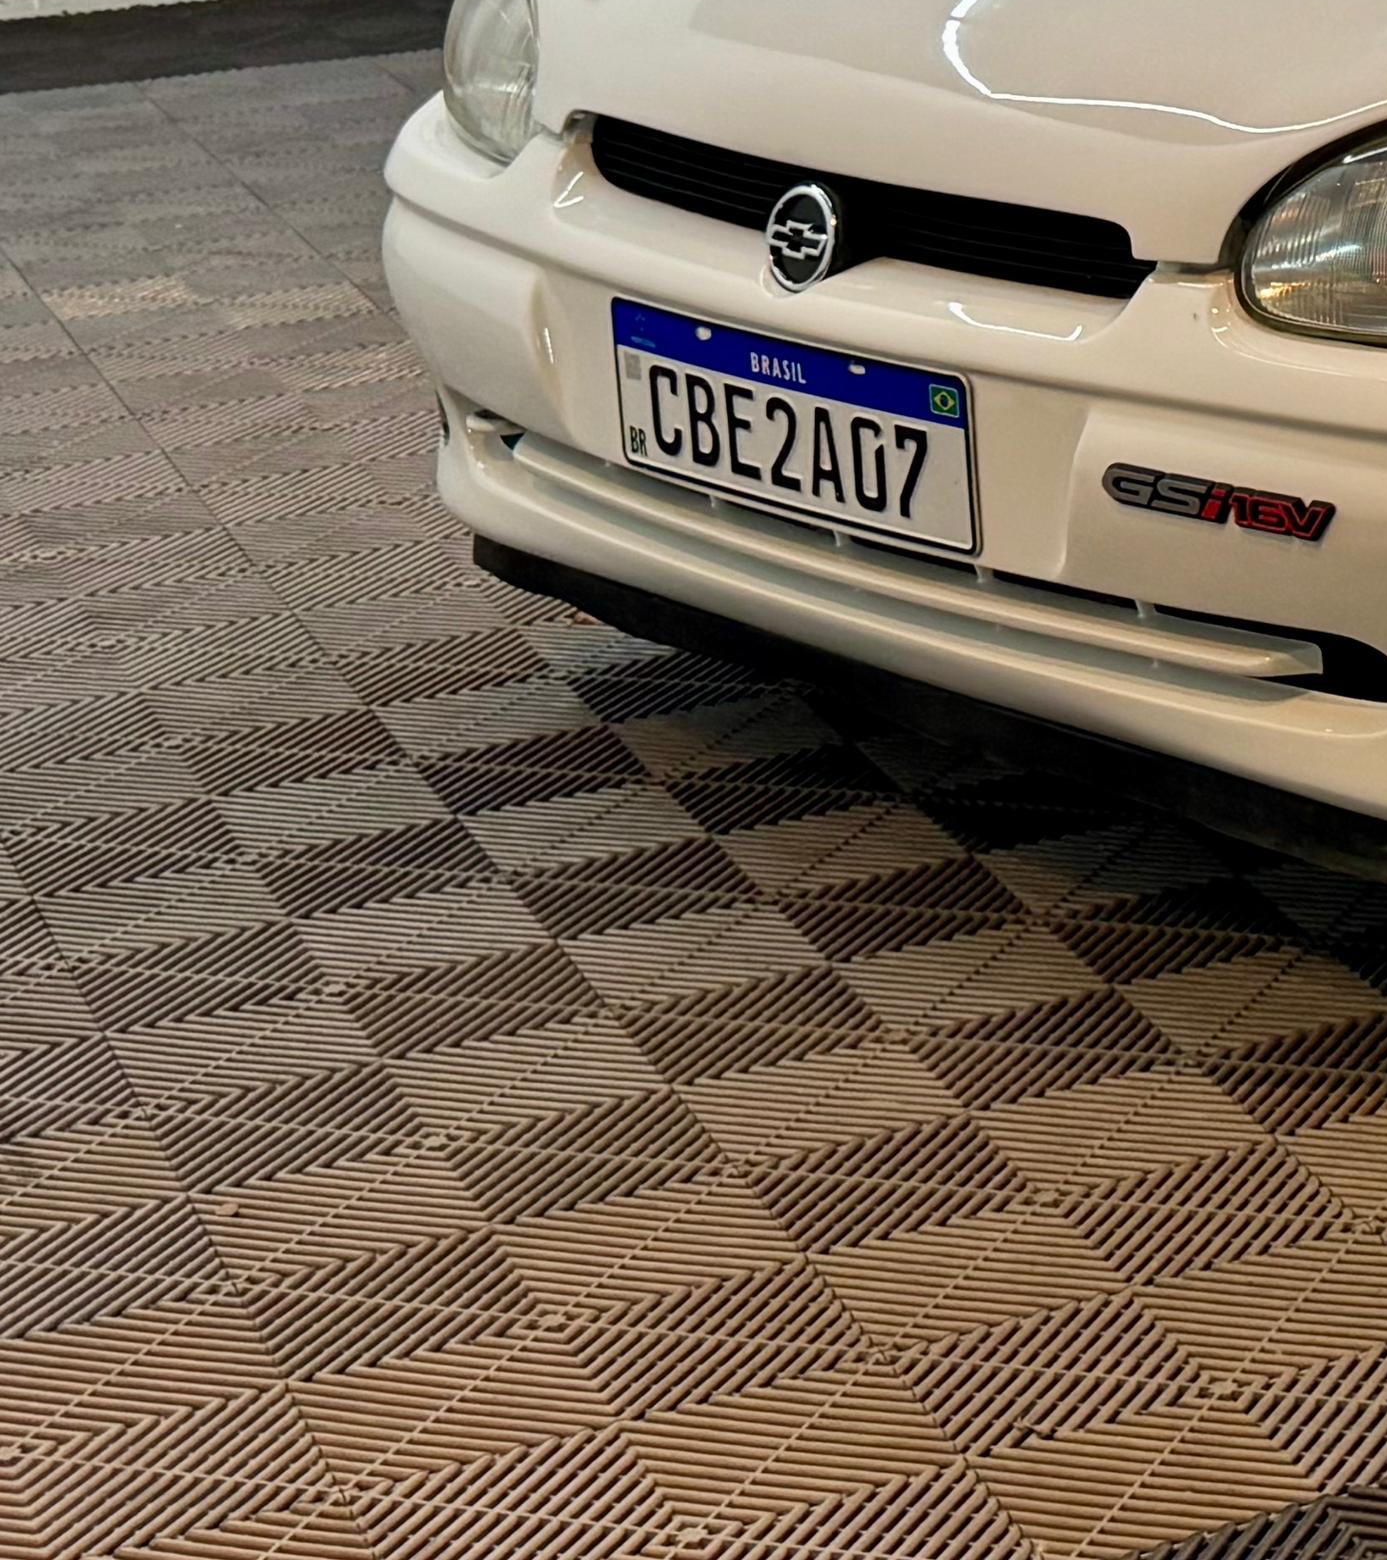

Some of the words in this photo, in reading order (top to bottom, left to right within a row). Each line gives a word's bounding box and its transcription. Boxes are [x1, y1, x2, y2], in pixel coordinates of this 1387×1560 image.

[750, 351, 807, 385] BRASIL
[629, 425, 648, 457] BR
[649, 364, 928, 519] CBE2A07
